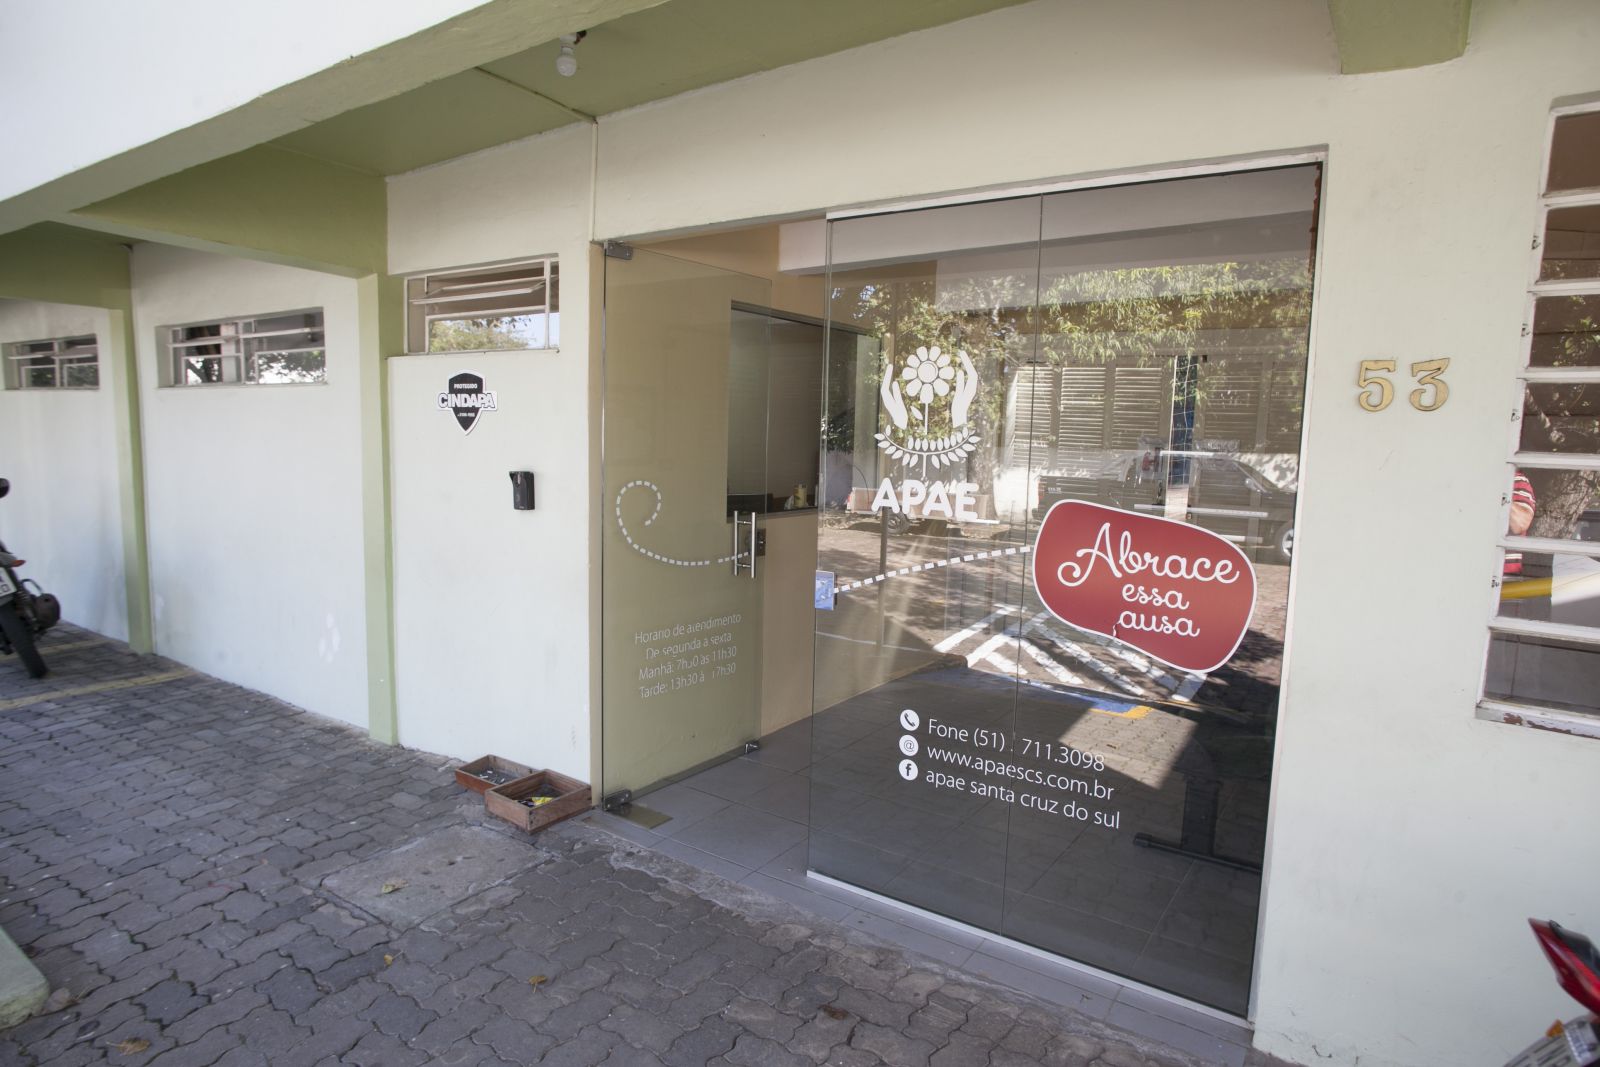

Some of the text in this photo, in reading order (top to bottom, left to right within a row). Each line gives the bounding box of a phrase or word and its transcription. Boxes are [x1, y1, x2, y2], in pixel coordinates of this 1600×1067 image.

[1358, 357, 1450, 412] 53
[438, 392, 496, 409] CINDAPA
[871, 477, 980, 521] APAE
[1057, 522, 1240, 587] Abrace
[1121, 583, 1190, 610] essa
[672, 624, 685, 637] de
[686, 614, 741, 632] atendimento
[646, 632, 732, 660] De segunda a sexta
[712, 645, 737, 662] 11h30
[671, 672, 698, 691] 13h30
[928, 718, 969, 742] Fone
[973, 727, 1005, 752] (51)
[927, 745, 1115, 801] www.apaescs.com.br
[926, 769, 1121, 830] apae santa cruz do sul
